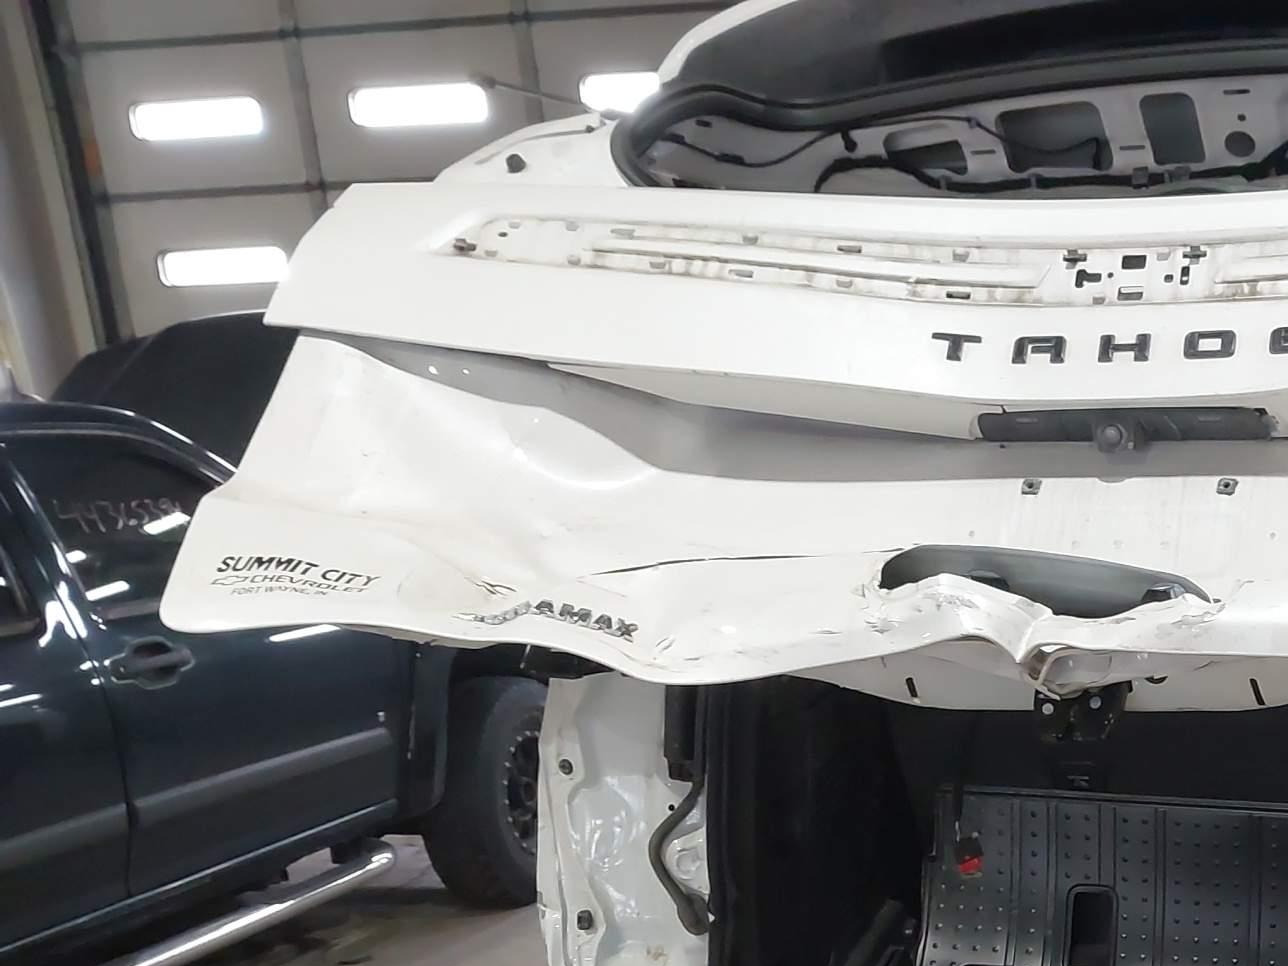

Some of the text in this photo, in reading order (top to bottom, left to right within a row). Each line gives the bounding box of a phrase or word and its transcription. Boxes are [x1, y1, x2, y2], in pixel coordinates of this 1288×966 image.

[216, 556, 382, 587] SUMMIT CITY
[249, 574, 370, 593] CHEVROLET
